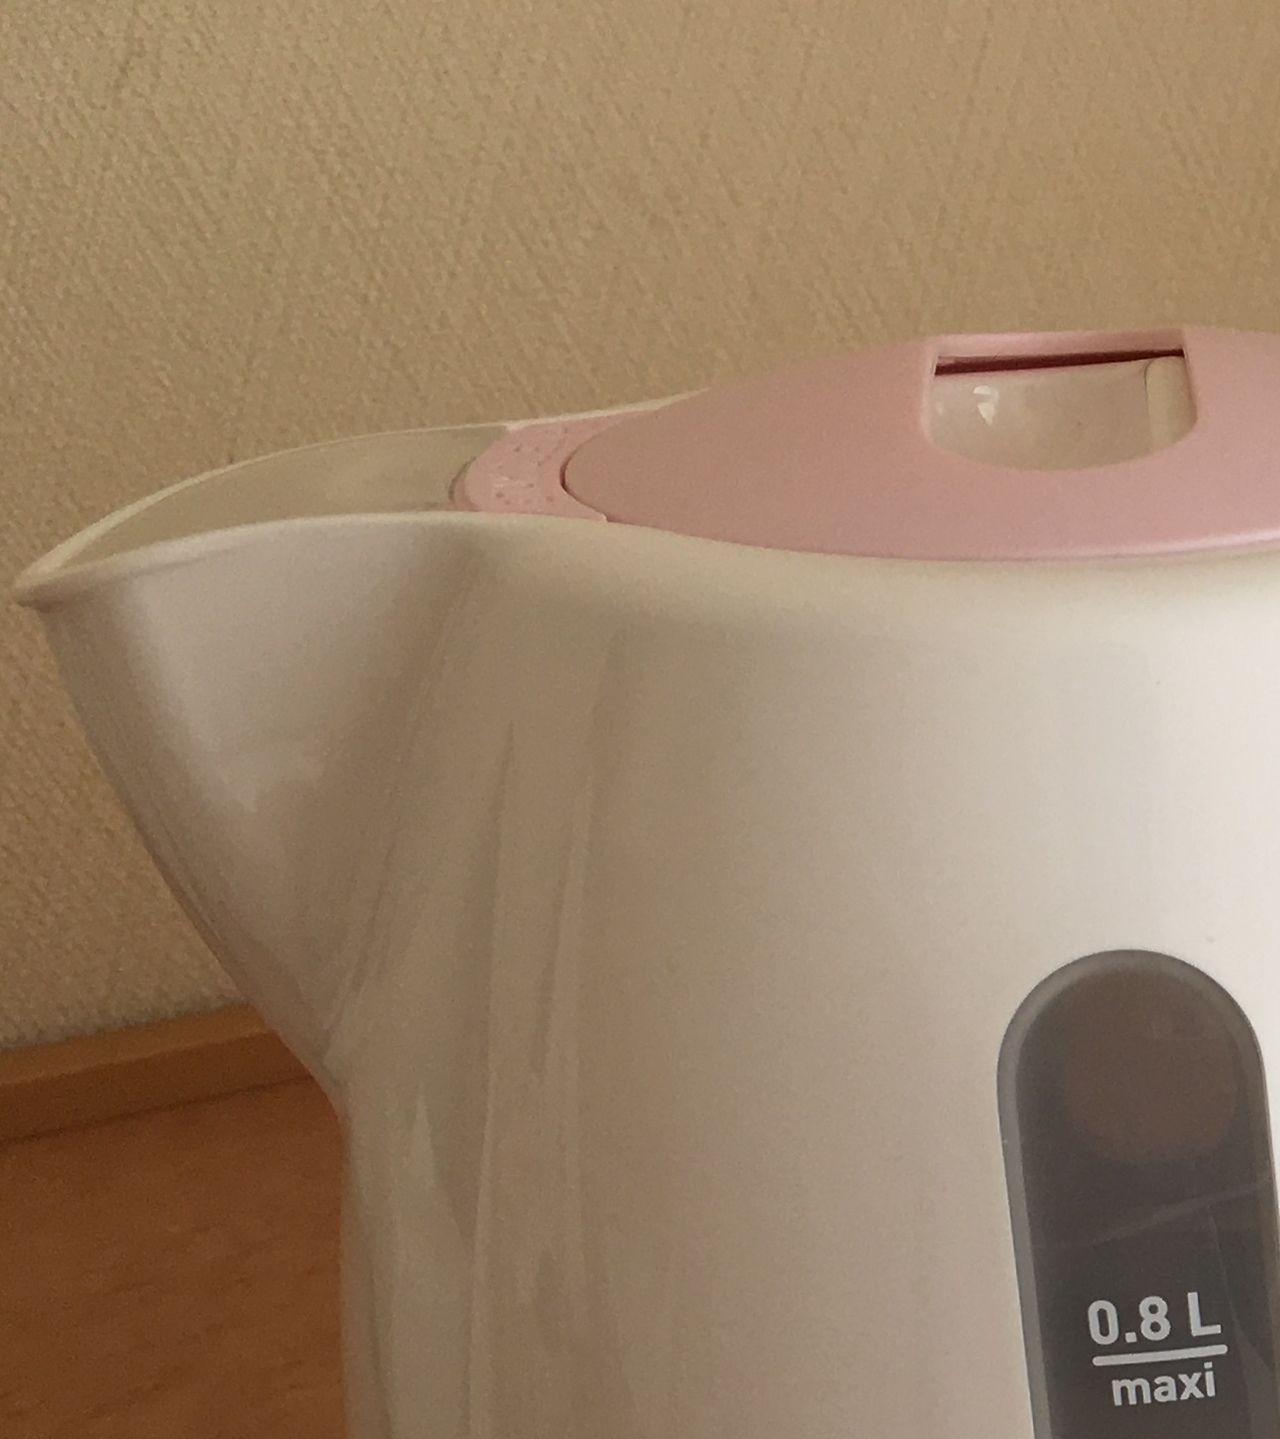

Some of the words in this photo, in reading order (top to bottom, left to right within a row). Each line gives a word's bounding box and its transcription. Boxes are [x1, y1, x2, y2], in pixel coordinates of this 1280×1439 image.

[1086, 1295, 1172, 1346] 0.8
[1187, 1291, 1222, 1338] L
[1111, 1361, 1217, 1407] maxi
